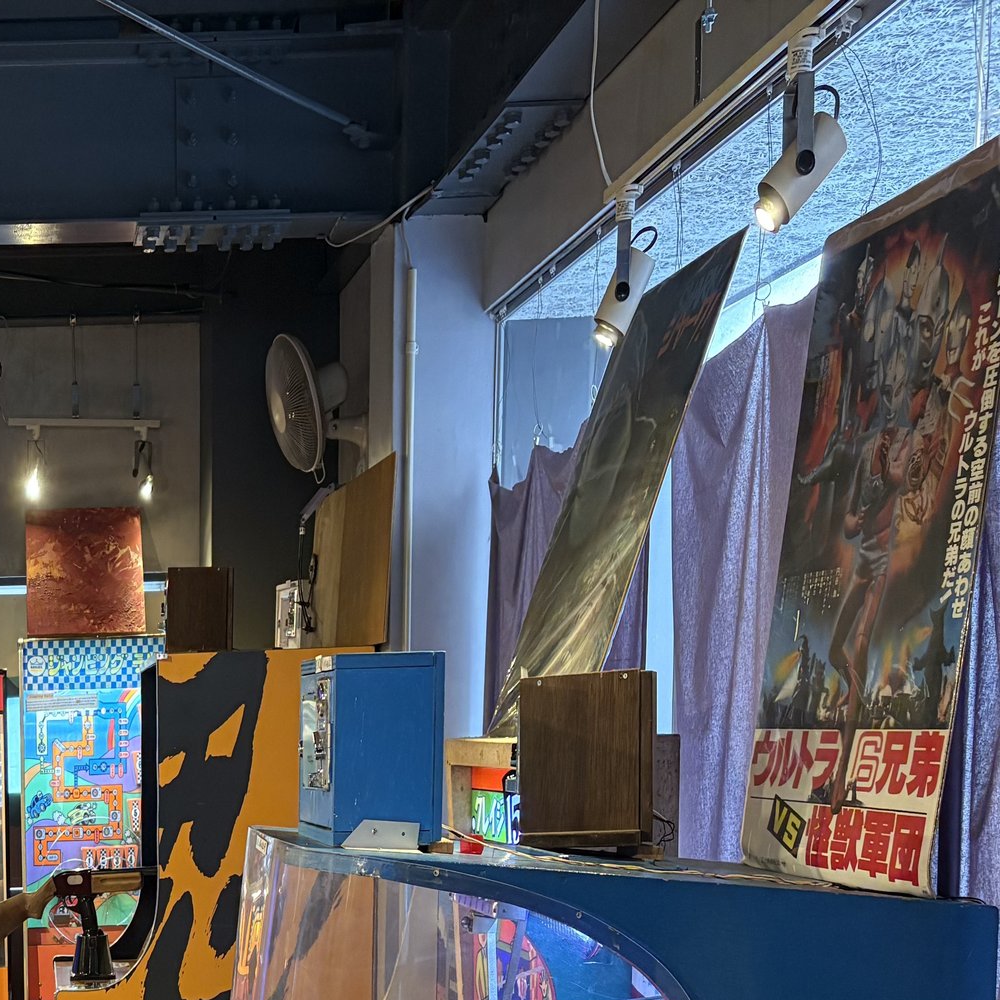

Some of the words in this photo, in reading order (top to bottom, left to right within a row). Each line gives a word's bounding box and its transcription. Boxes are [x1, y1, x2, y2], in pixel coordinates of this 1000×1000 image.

[971, 301, 992, 371] これが
[48, 652, 128, 676] ジャンピング
[773, 797, 802, 850] VS
[805, 805, 927, 887] 怪獣軍団
